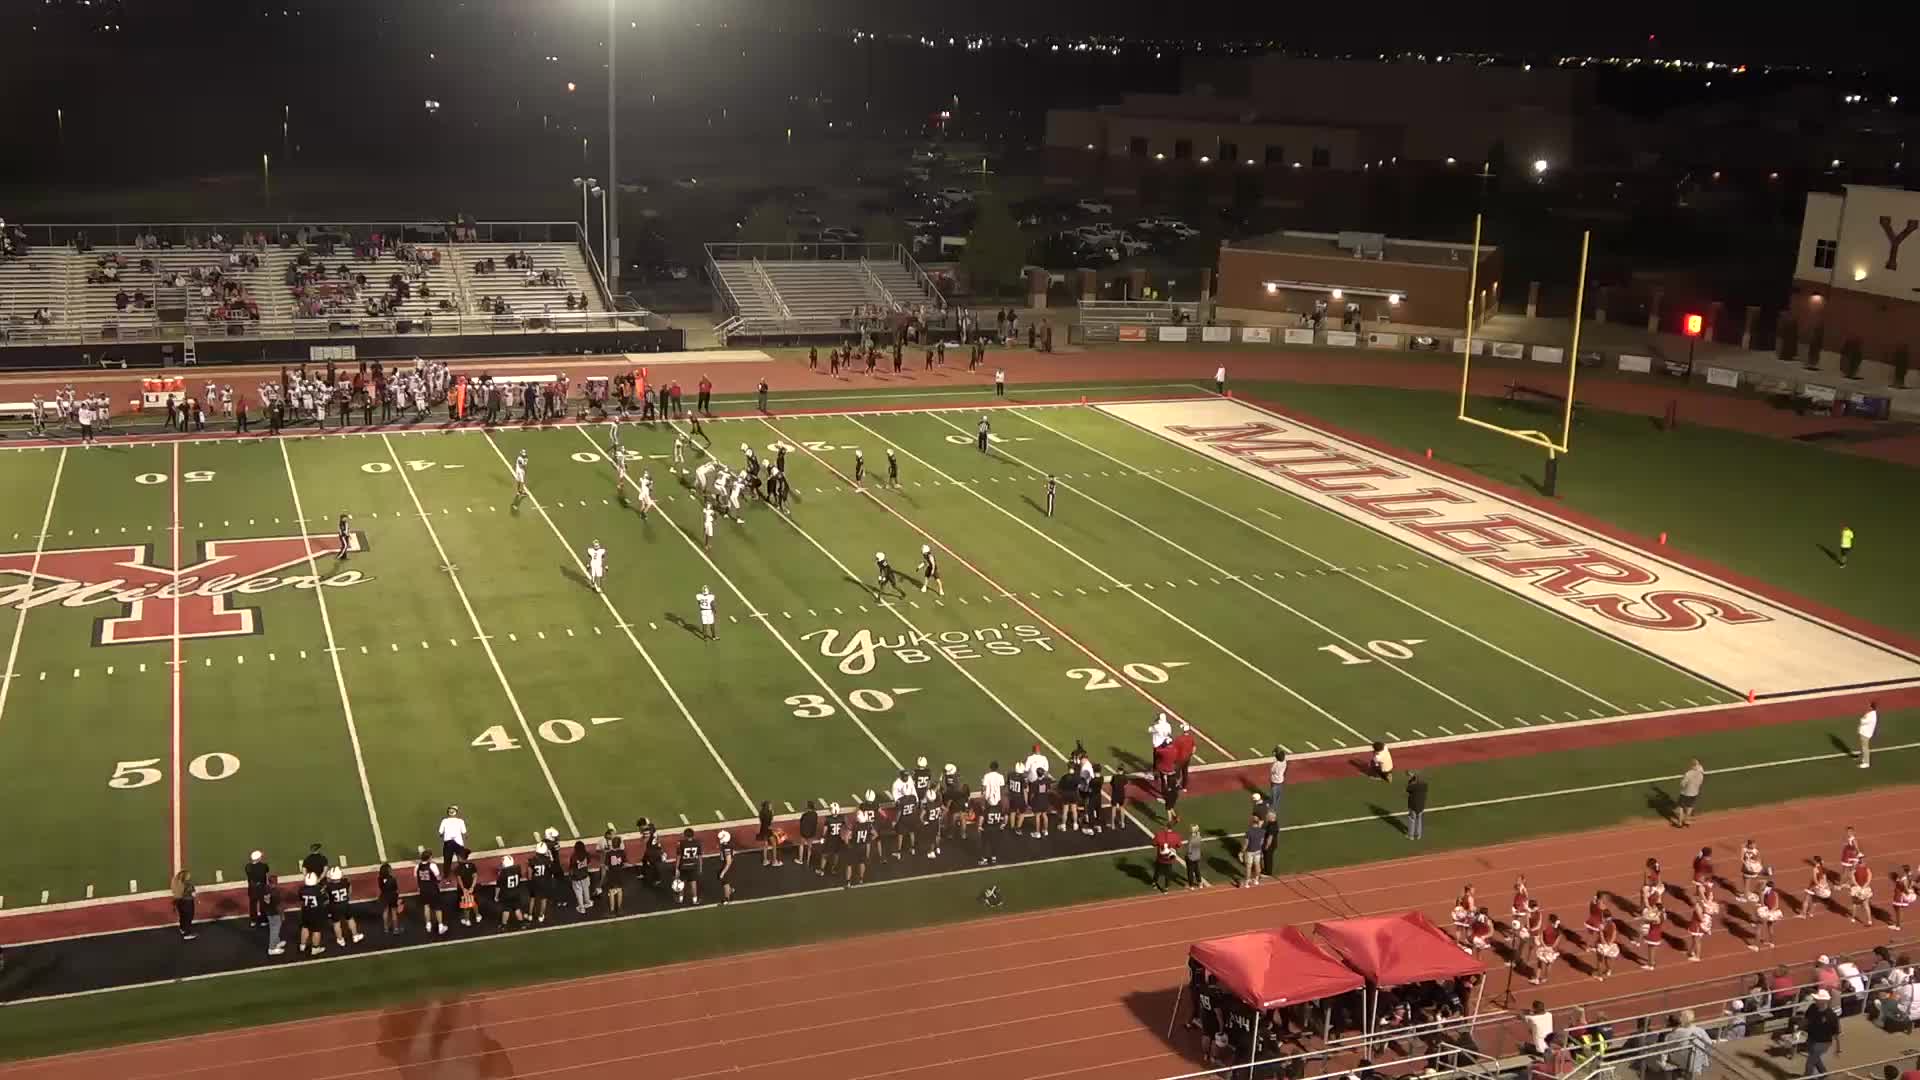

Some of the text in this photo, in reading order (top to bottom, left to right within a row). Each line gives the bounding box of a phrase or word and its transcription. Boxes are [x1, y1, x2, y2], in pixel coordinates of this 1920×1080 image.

[1879, 215, 1919, 271] Y
[135, 470, 216, 485] 50
[1164, 421, 1776, 631] MILLERS
[800, 623, 1041, 675] Yukon's
[893, 636, 1054, 664] BEST
[1317, 639, 1414, 665] 10
[1065, 662, 1170, 691] 20
[784, 688, 895, 718] 30
[471, 719, 587, 753] 40
[108, 752, 241, 789] 50
[917, 776, 929, 789] 25
[987, 812, 1001, 825] 54
[857, 830, 868, 843] 14
[507, 875, 519, 889] 61
[534, 863, 546, 877] 31
[302, 895, 319, 909] 73
[331, 887, 348, 903] 32
